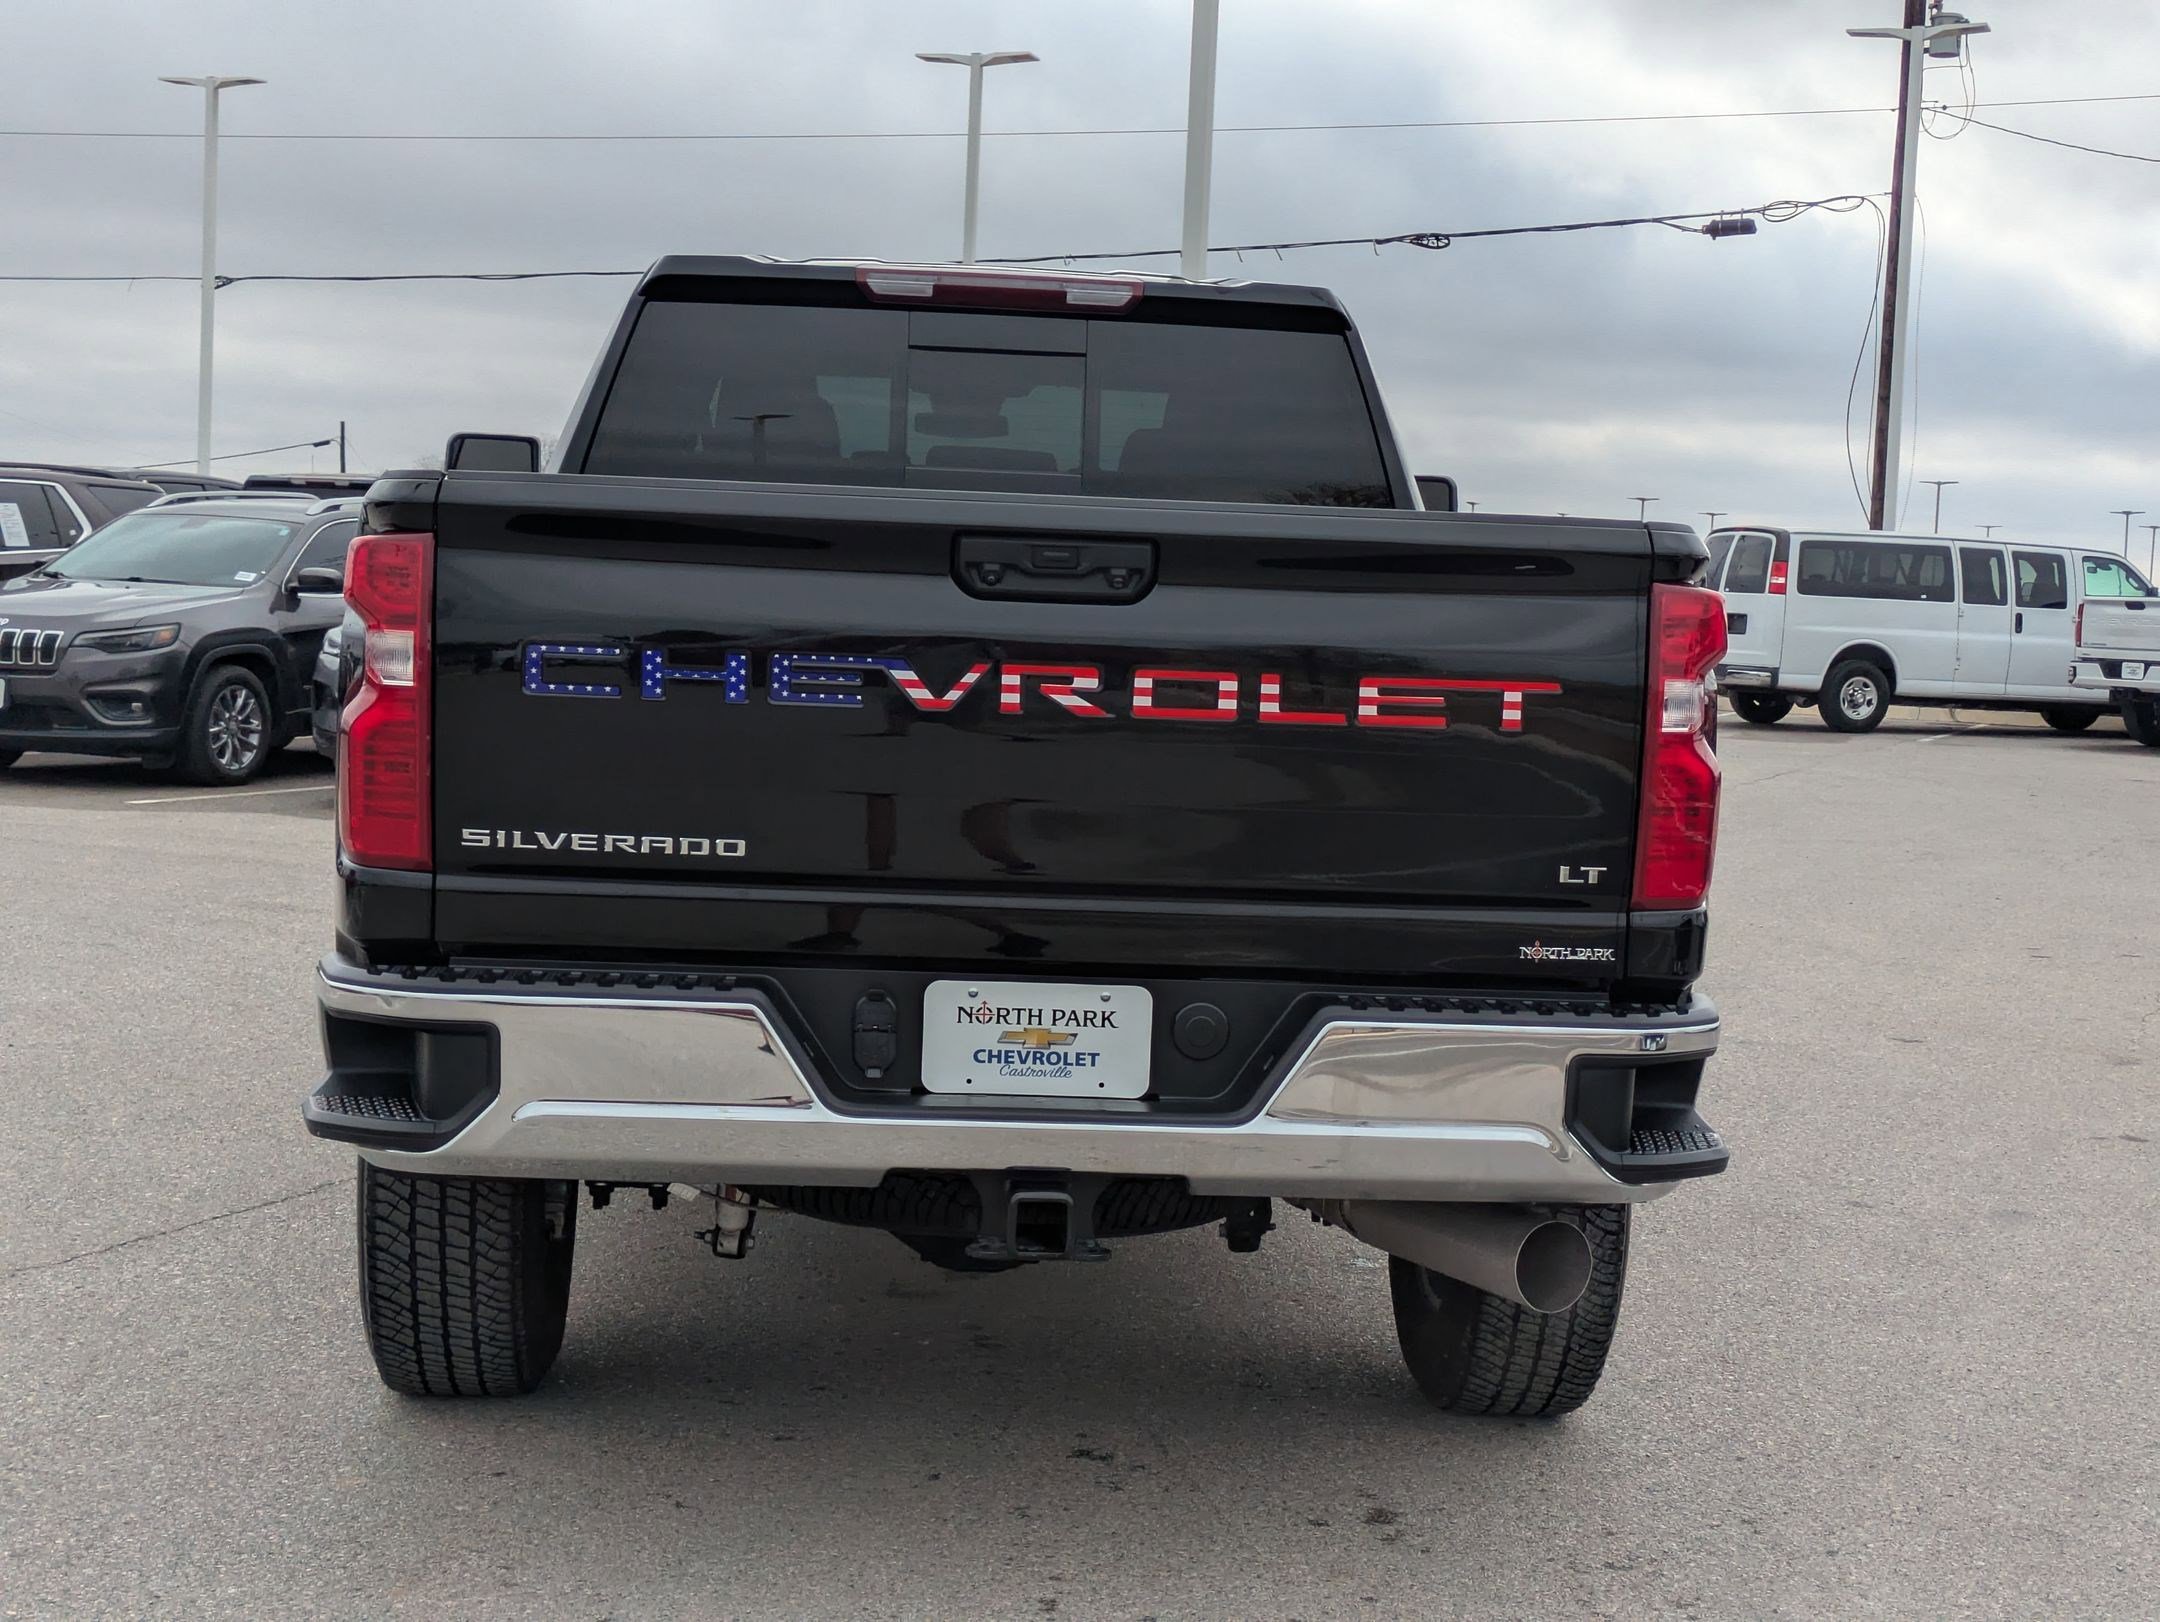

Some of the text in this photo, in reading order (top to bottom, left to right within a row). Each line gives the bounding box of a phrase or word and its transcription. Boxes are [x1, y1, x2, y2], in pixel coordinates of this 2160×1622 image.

[521, 641, 1563, 733] CHEVROLET
[460, 828, 747, 857] SILVERADO
[1558, 865, 1608, 884] LT
[1518, 945, 1616, 961] NORTH PARK
[956, 1003, 1120, 1029] NORTH PARK
[972, 1048, 1101, 1068] CHEVROLET
[999, 1063, 1073, 1079] Castroville
